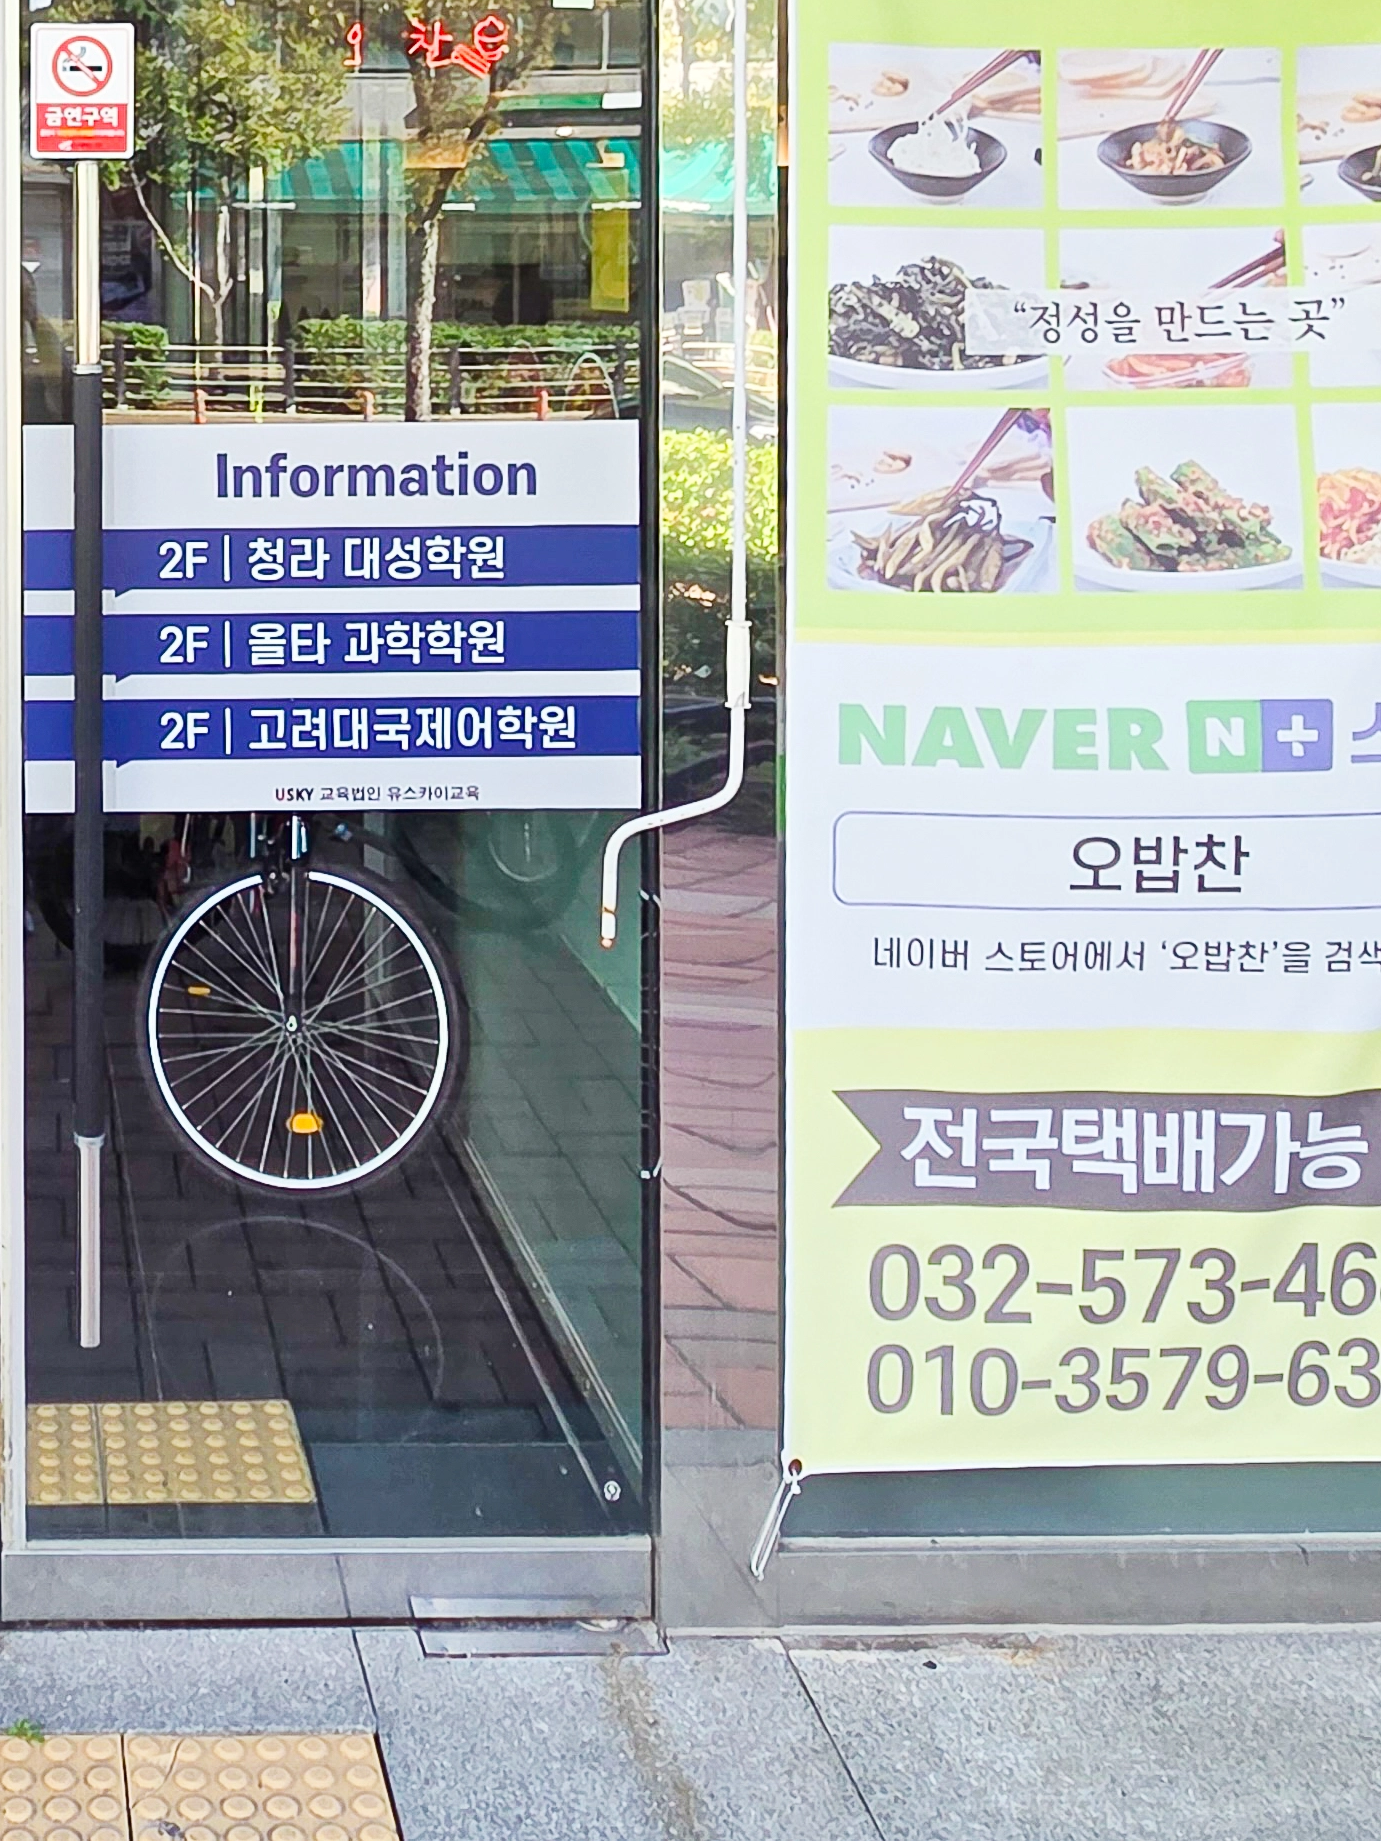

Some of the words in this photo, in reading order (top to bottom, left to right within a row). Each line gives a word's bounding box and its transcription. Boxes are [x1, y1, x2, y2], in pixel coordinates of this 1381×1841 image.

[44, 106, 118, 127] 금연구역
[1156, 300, 1275, 344] 만드는
[217, 451, 537, 499] Information
[158, 541, 209, 579] 2F
[247, 536, 331, 580] 청라
[343, 536, 507, 580] 대성학원
[158, 626, 209, 664] 2F
[248, 621, 331, 665] 올타
[344, 621, 507, 665] 과학학원
[159, 712, 210, 751] 2F
[248, 705, 578, 751] 고려대국제어학원
[838, 702, 1169, 772] NAVER
[275, 788, 314, 802] USKY
[320, 787, 381, 802] 교육법인
[387, 786, 480, 802] 유스카이교육
[1069, 834, 1250, 895] 오밥찬
[873, 936, 969, 972] 네이버
[985, 939, 1146, 974] 스토어에서
[900, 1105, 1369, 1195] 전국택배가능
[867, 1337, 1381, 1416] 010-3579-63
